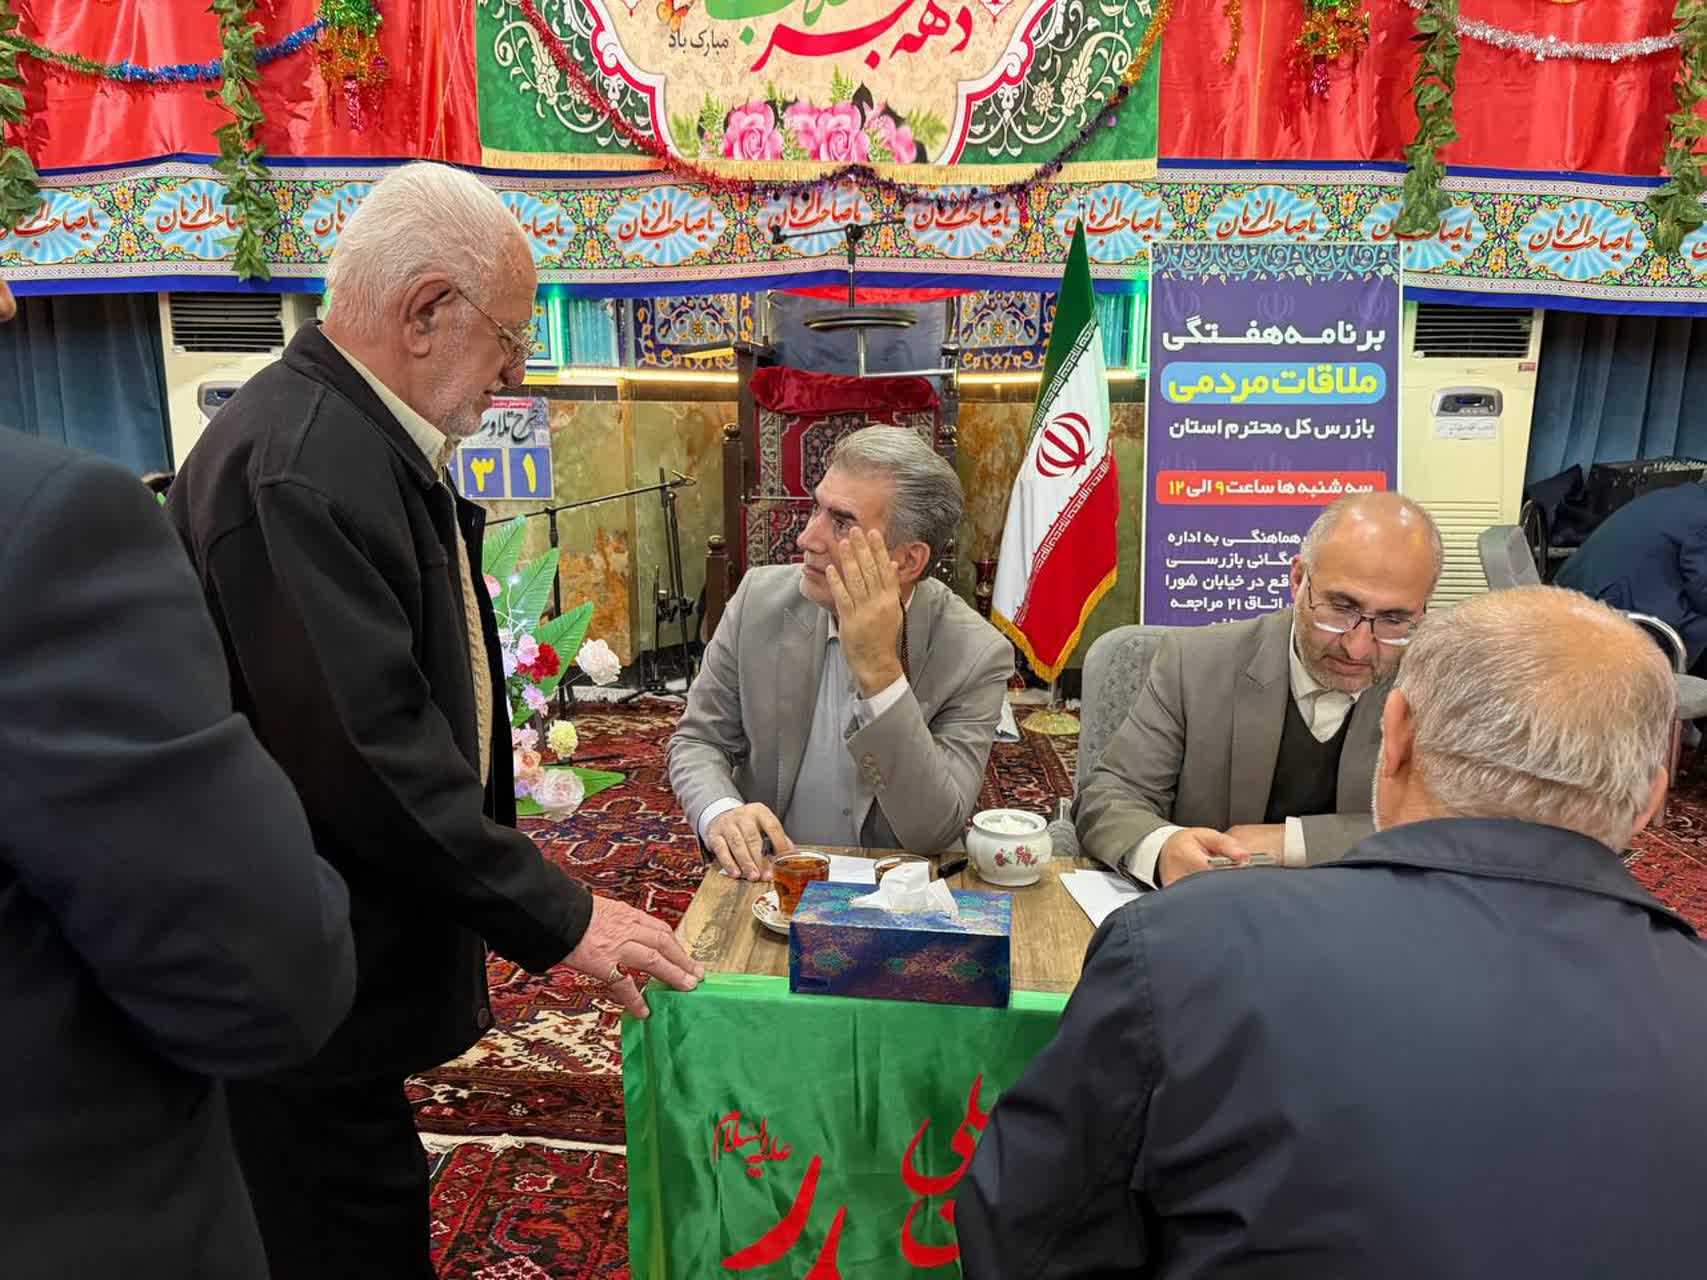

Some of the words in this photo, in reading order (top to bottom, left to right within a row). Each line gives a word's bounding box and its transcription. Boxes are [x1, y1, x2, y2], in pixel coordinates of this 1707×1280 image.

[668, 28, 688, 49] باد
[690, 27, 729, 57] مبارک
[618, 199, 673, 241] الزمان
[640, 211, 708, 249] صاحب
[934, 205, 1002, 240] صاحب
[1085, 209, 1154, 246] صاحب
[1216, 199, 1277, 240] الزمان
[1528, 213, 1594, 252] الزمان
[1551, 228, 1626, 263] صاحب
[1162, 315, 1282, 351] هفتگی
[1284, 320, 1386, 351] برنامه
[1168, 371, 1270, 403] مردمی
[1271, 363, 1378, 394] ملاقات
[1168, 417, 1223, 440] استان
[1224, 418, 1282, 440] محترم
[1285, 417, 1312, 440] کل
[1314, 417, 1375, 440] بازرس
[1168, 480, 1185, 494] ۱۲
[1186, 479, 1212, 498] الی
[1215, 480, 1225, 497] ۹
[1225, 479, 1275, 495] ساعت
[1277, 479, 1295, 495] ها
[1297, 478, 1343, 498] شنبه
[1344, 482, 1373, 494] سه
[1167, 531, 1201, 547] اداره
[1203, 533, 1219, 547] به
[1222, 529, 1302, 547] هماهنگی
[1166, 552, 1244, 568] بازرسی
[1165, 573, 1198, 590] شورا
[1202, 573, 1246, 591] خیابان
[1246, 576, 1265, 591] در
[1267, 573, 1290, 594] قع
[1170, 597, 1224, 612] مراجعه
[1227, 597, 1241, 610] ۲۱
[1244, 595, 1283, 610] اتاق
